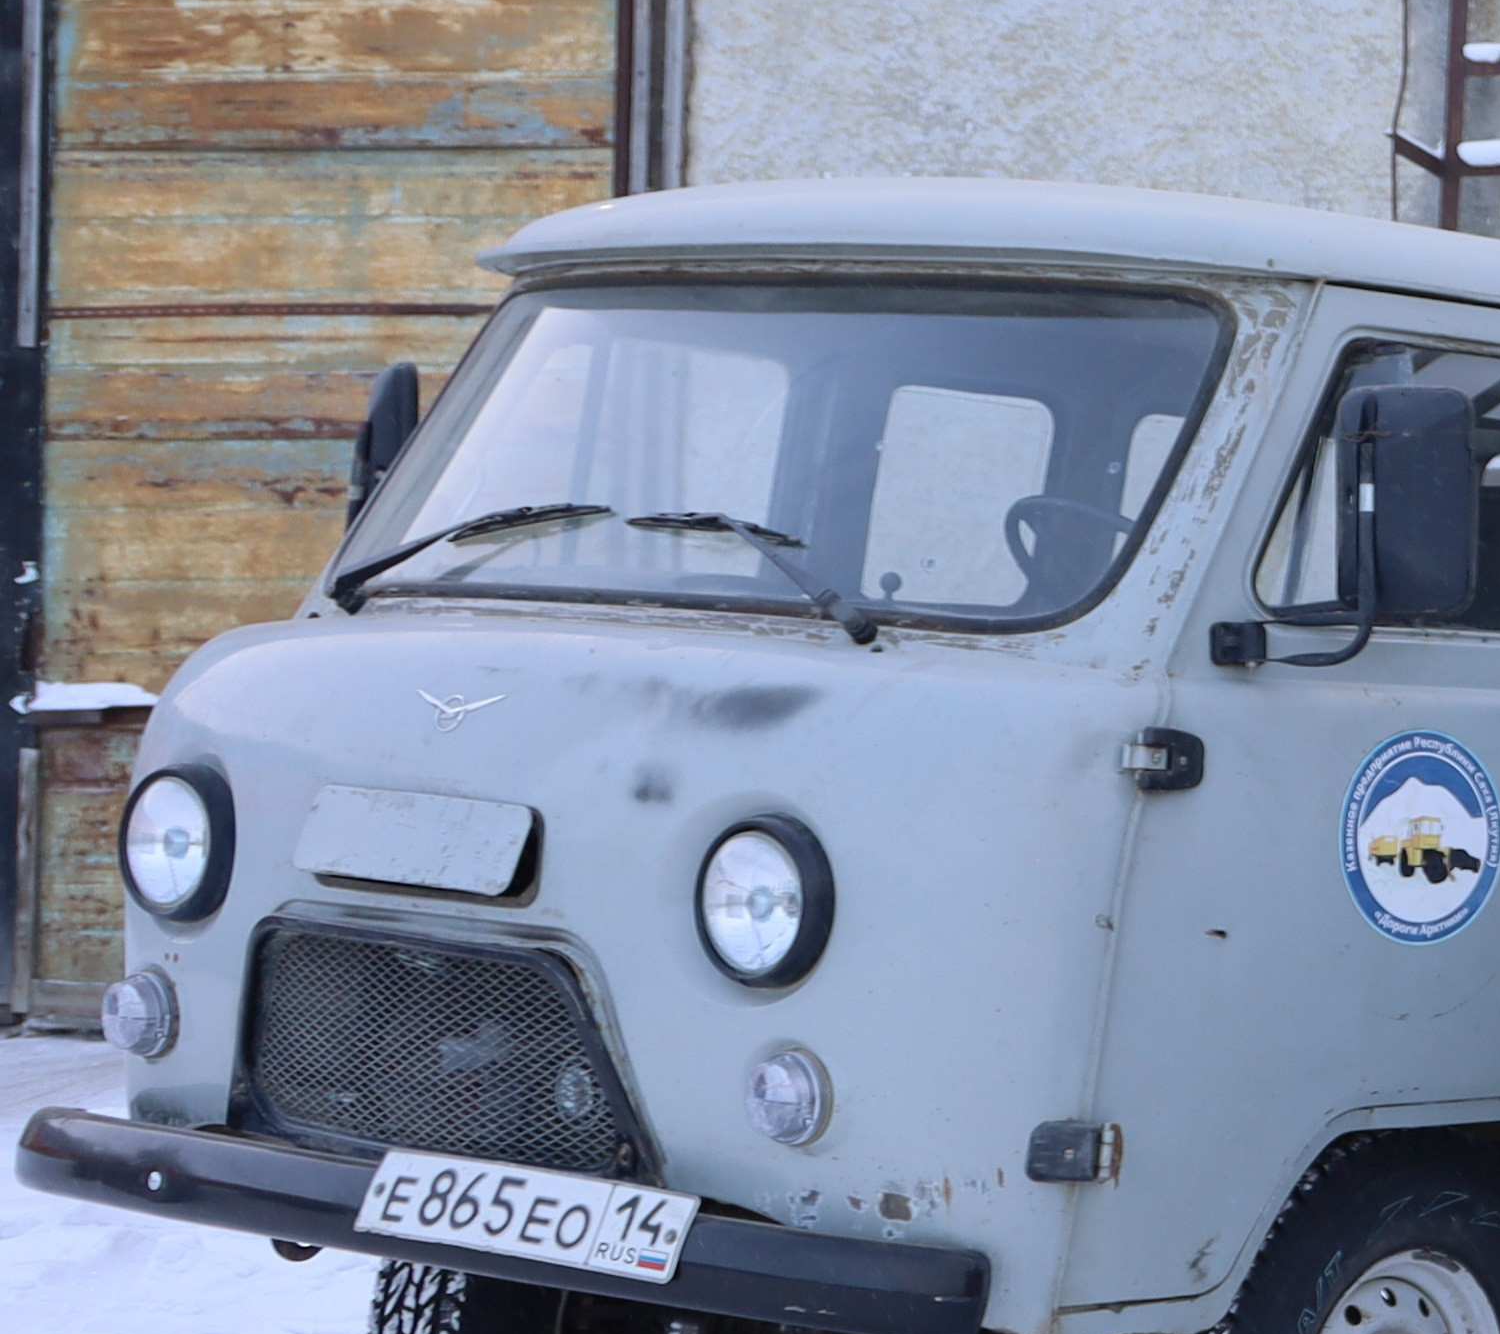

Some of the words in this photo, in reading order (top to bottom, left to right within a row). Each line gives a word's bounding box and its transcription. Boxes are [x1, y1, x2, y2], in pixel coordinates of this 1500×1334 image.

[1413, 736, 1476, 775] Республики
[1474, 771, 1493, 804] Саха
[614, 1193, 667, 1247] 14
[595, 1241, 637, 1265] RUS
